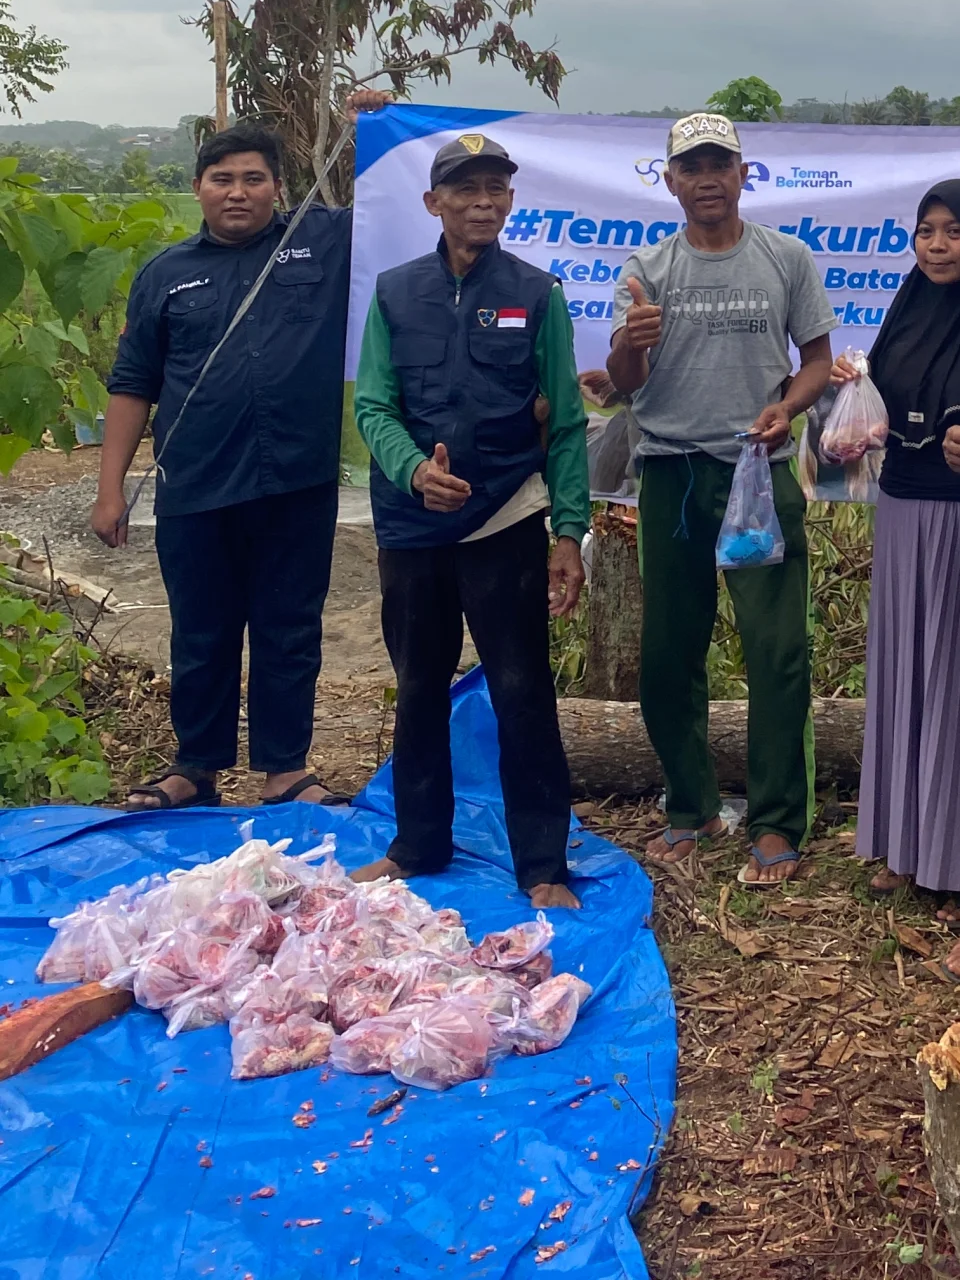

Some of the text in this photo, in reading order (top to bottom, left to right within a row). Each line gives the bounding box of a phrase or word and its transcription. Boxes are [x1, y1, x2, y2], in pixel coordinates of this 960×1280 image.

[679, 118, 729, 139] BAD
[790, 166, 839, 179] Teman
[775, 176, 853, 188] Berkurban
[824, 267, 906, 290] Bata
[667, 288, 770, 325] SQUAD
[707, 320, 725, 329] TASK
[749, 318, 768, 334] 68
